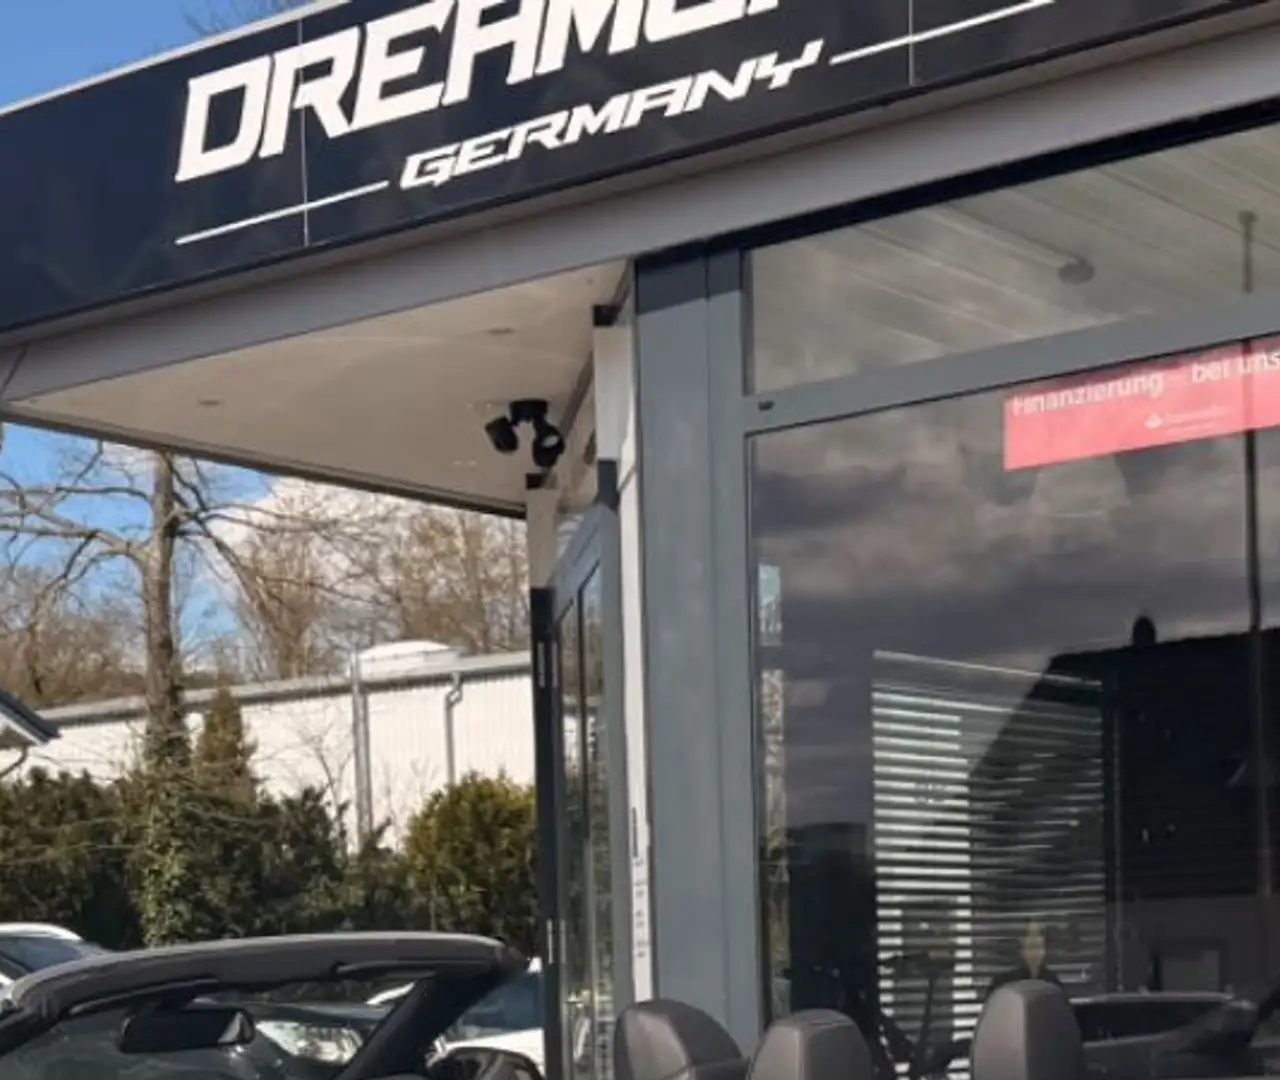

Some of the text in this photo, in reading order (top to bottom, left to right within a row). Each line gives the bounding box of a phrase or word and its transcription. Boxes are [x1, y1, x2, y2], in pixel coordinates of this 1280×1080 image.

[174, 0, 777, 182] DREAM
[399, 38, 824, 190] GERMANY
[1012, 371, 1165, 415] Finanzierung
[1191, 359, 1232, 384] bei
